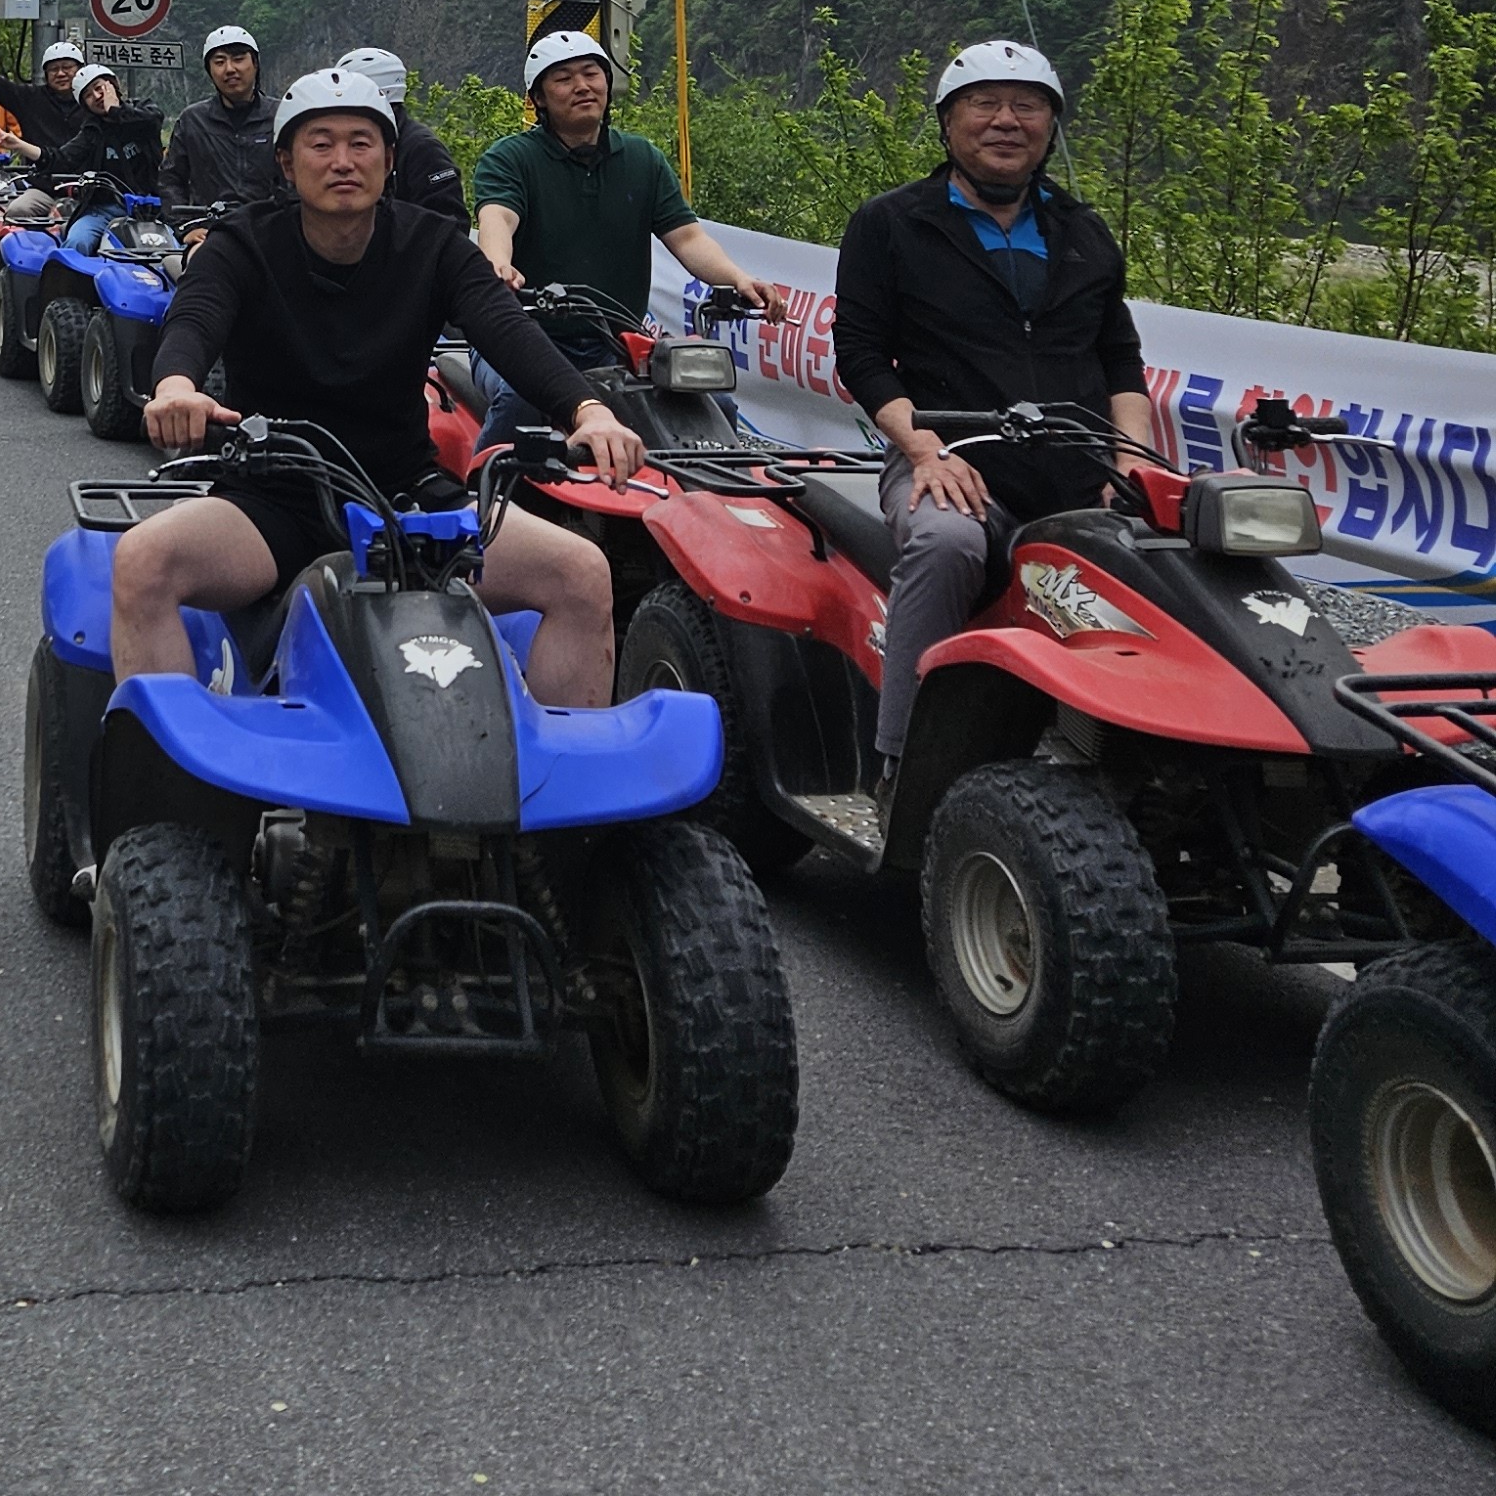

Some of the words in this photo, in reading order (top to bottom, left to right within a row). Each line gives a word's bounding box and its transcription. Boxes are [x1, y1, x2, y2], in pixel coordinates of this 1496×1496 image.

[92, 44, 143, 65] 구내속도
[150, 47, 176, 66] 준수
[757, 282, 856, 405] 준비운
